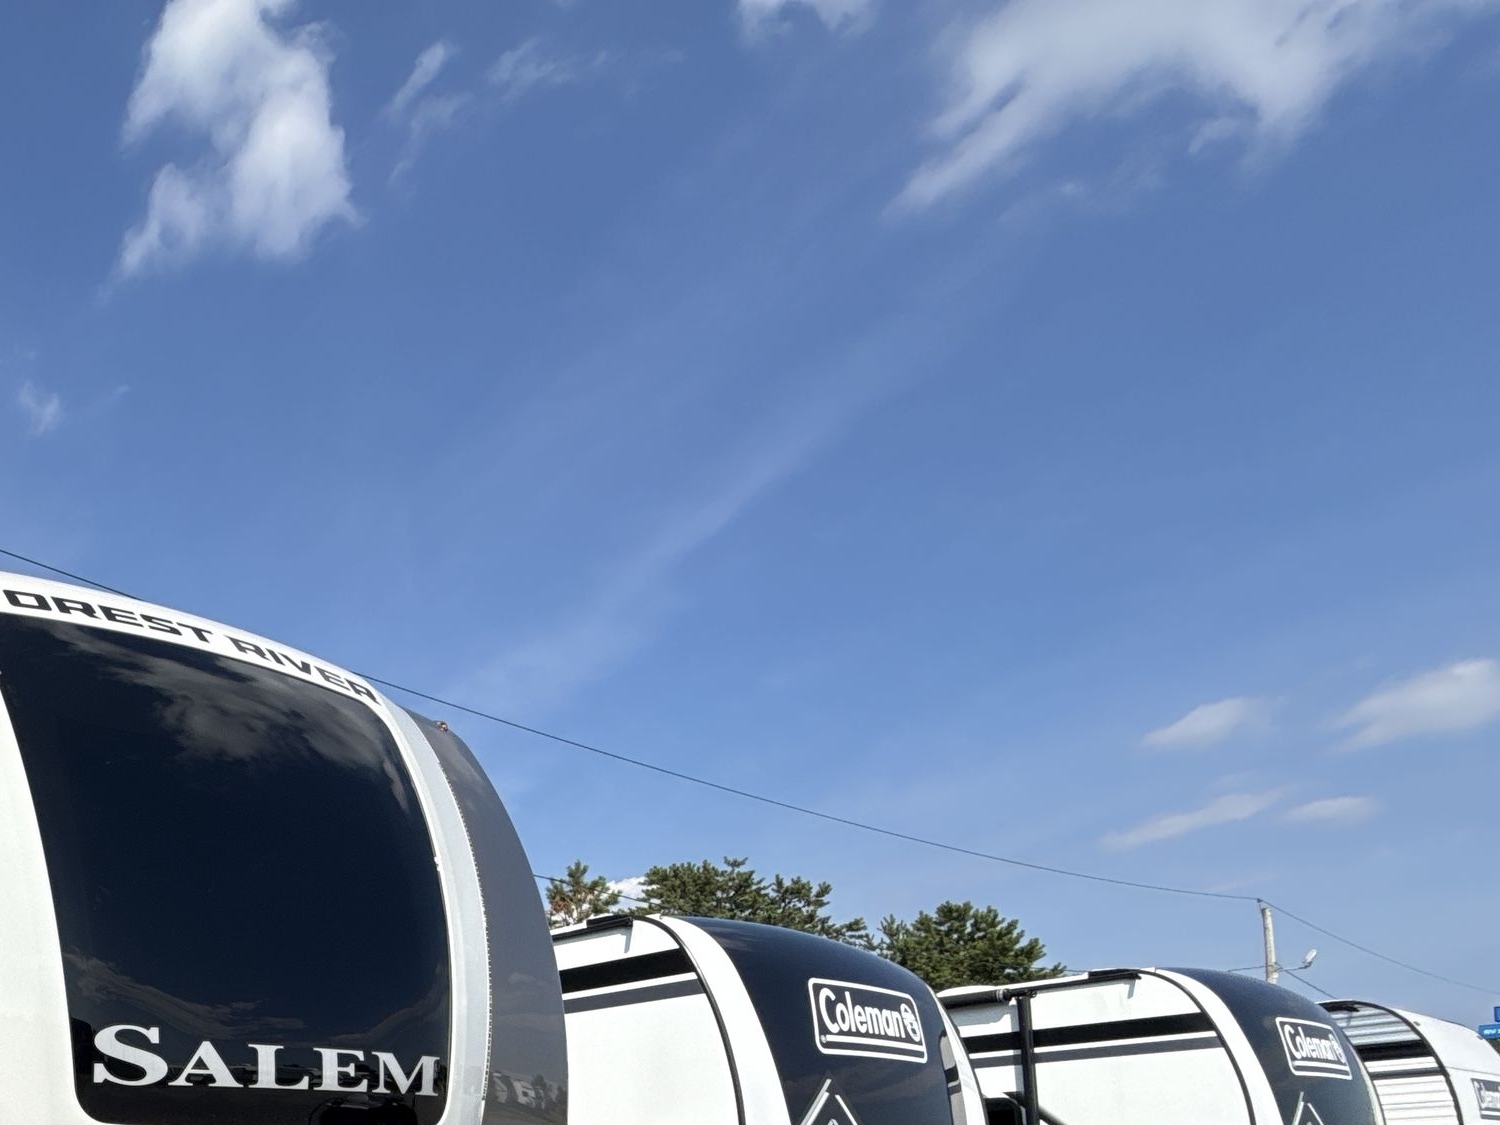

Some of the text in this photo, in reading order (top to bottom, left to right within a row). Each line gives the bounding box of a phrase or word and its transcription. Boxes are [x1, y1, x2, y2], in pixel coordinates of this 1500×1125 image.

[225, 634, 382, 704] RIVER
[818, 987, 906, 1039] Coleman
[1283, 1024, 1338, 1061] Coleman
[92, 1023, 441, 1097] SALEM
